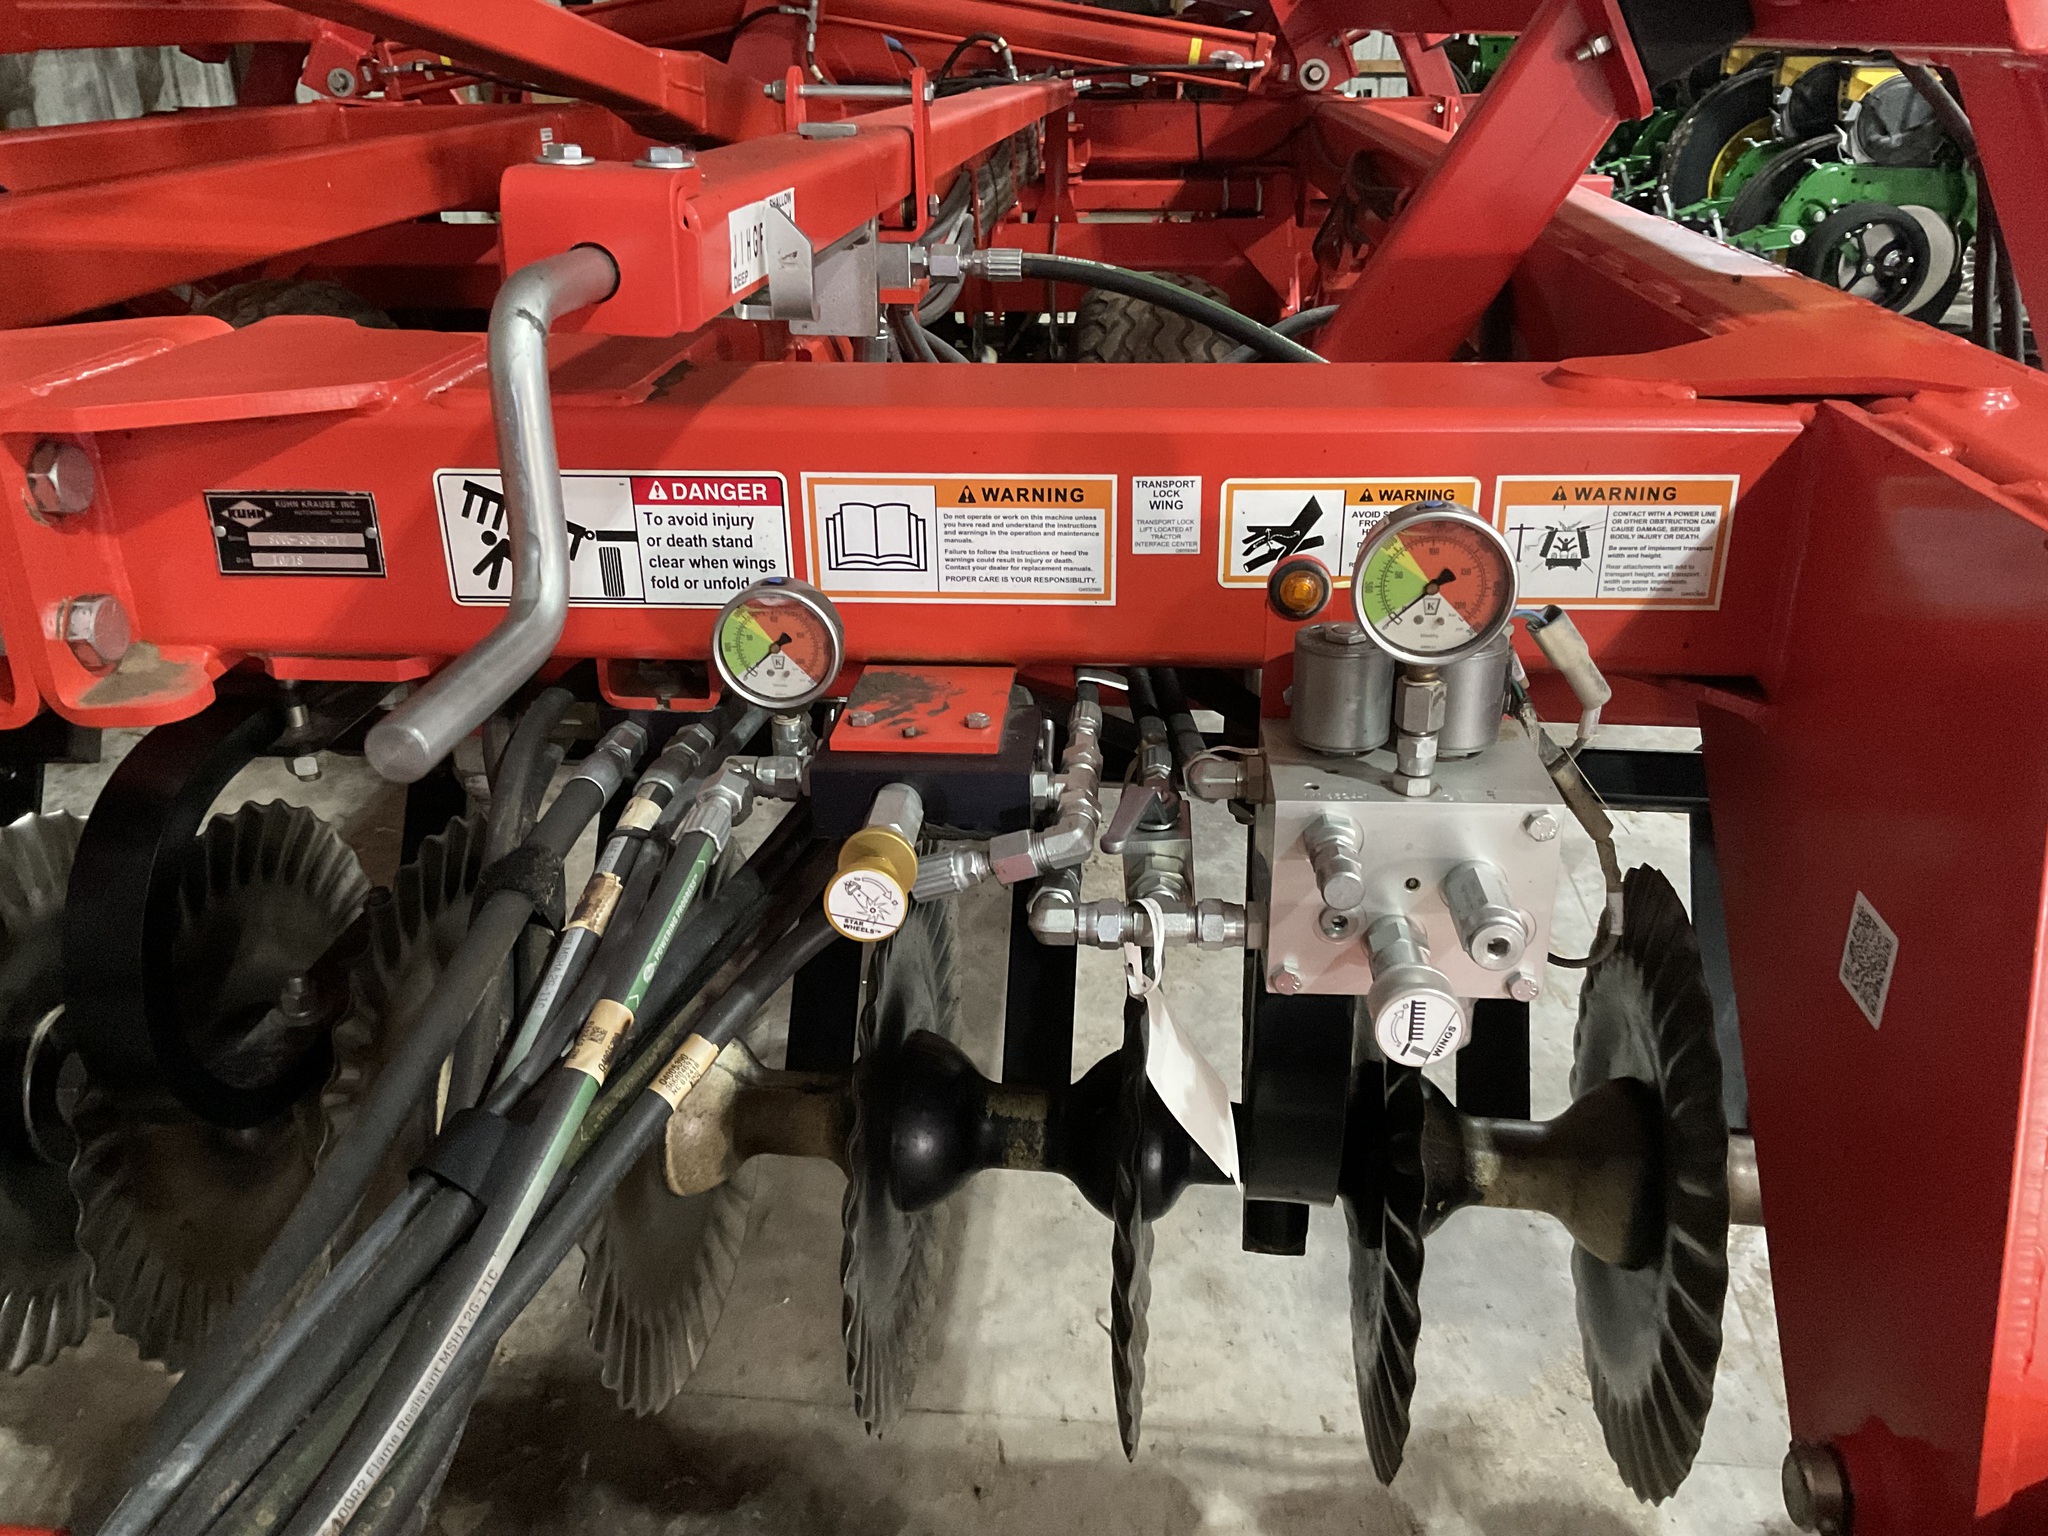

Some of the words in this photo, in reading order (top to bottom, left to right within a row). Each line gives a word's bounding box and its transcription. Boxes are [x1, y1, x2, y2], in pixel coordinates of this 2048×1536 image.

[734, 270, 748, 288] DEEP
[672, 483, 767, 500] DANGER
[982, 488, 1084, 502] WARNING
[1379, 490, 1455, 502] WARNING
[1574, 487, 1677, 500] WARNING
[1149, 500, 1183, 510] WING
[228, 508, 267, 519] KUHN
[643, 512, 663, 526] To
[668, 512, 708, 526] avoid
[712, 513, 754, 530] injury
[647, 537, 661, 547] or
[667, 534, 708, 547] death
[712, 535, 753, 548] stand
[649, 555, 684, 568] clear
[689, 556, 728, 568] when
[733, 556, 776, 572] wings
[651, 576, 679, 588] fold
[684, 579, 699, 589] or
[704, 577, 750, 589] unfold
[651, 915, 680, 960] POWERING
[1432, 1025, 1456, 1057] WINGS
[364, 1430, 400, 1480] Flame
[395, 1363, 443, 1434] Resistant
[437, 1322, 468, 1364] MSHA
[461, 1267, 500, 1323] 2G-11C
